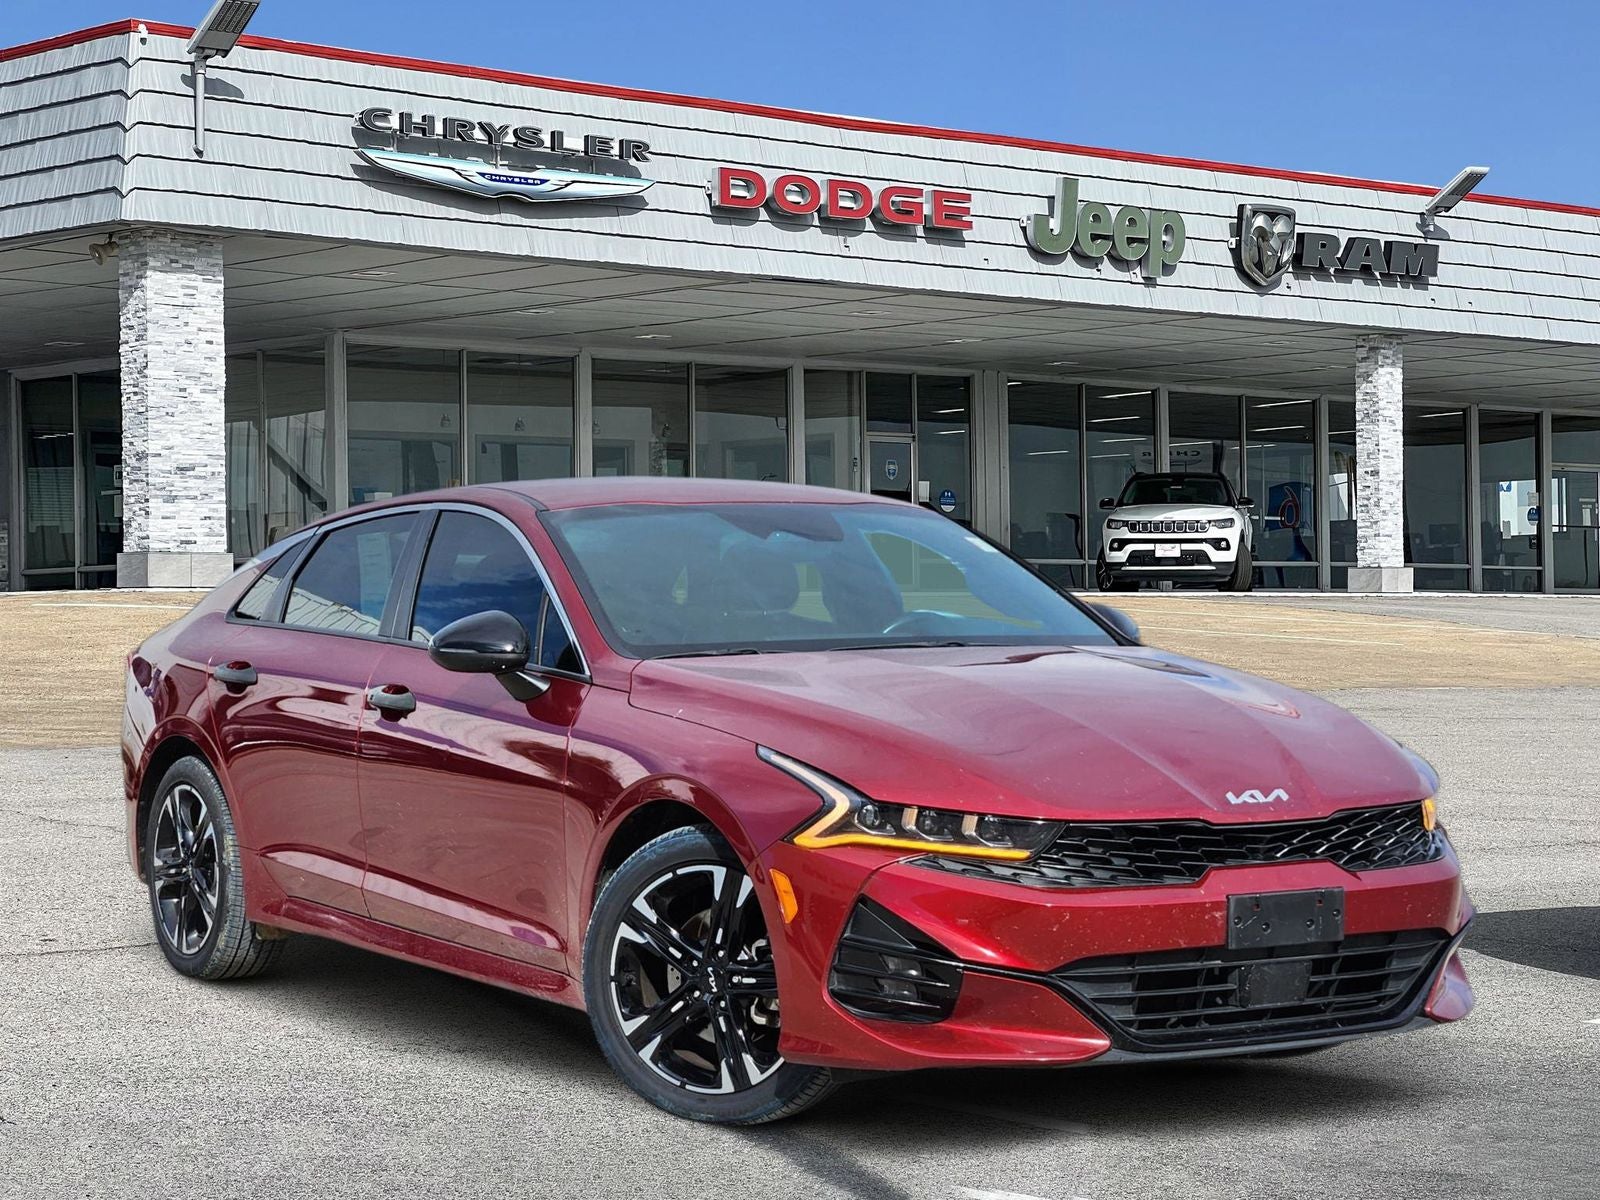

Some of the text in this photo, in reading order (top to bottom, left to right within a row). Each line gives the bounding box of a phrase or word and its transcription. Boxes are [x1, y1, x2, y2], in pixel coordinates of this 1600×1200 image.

[358, 106, 651, 162] CHRYSLER
[484, 174, 541, 185] CHRYSLER
[711, 166, 974, 231] DODGE
[1026, 176, 1186, 278] Jeep
[1296, 232, 1440, 277] RAM
[1225, 788, 1289, 804] KIA
